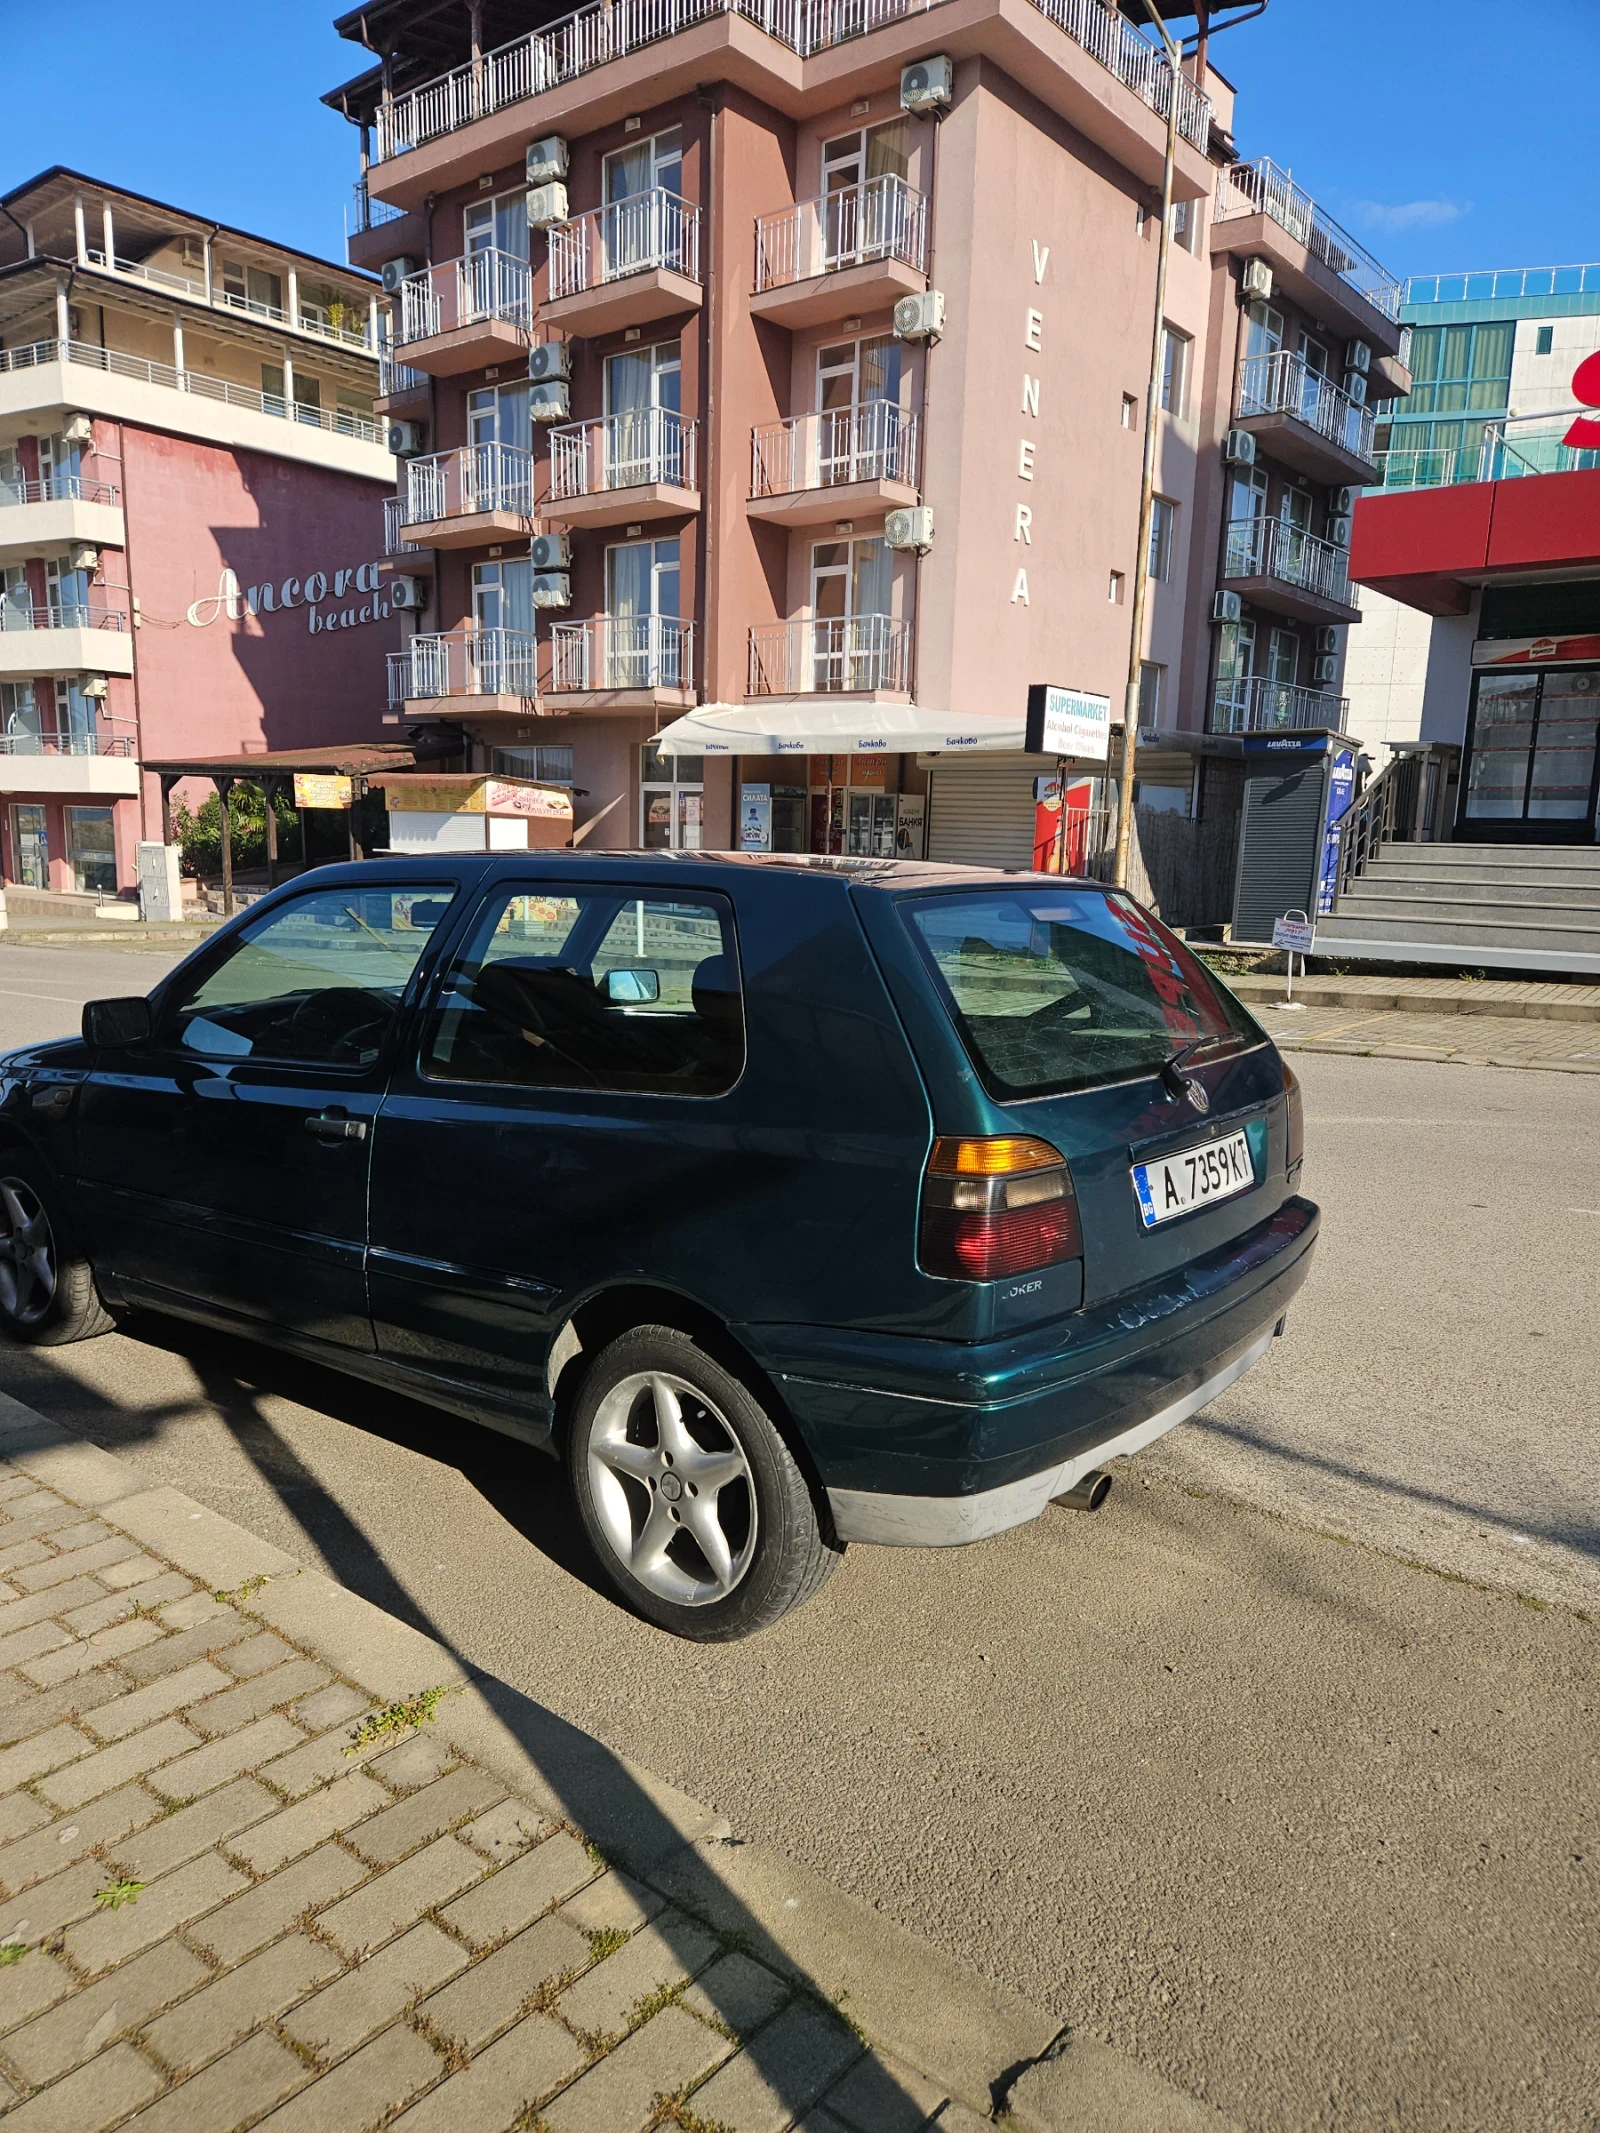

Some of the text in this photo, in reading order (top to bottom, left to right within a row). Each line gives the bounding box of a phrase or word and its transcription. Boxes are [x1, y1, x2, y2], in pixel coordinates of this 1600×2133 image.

[1010, 238, 1049, 607] VENERA
[187, 562, 387, 627] Ancora
[309, 592, 393, 635] beach
[1049, 693, 1108, 722] SUPERMARKET
[1046, 719, 1108, 740] Alcohol Cigarettes
[858, 739, 887, 748] Бачково
[946, 736, 978, 746] Бачково
[1058, 738, 1074, 751] Beer
[1267, 739, 1302, 748] LAVAZZA
[899, 817, 922, 826] БАНКЯ
[1143, 1202, 1154, 1217] BG
